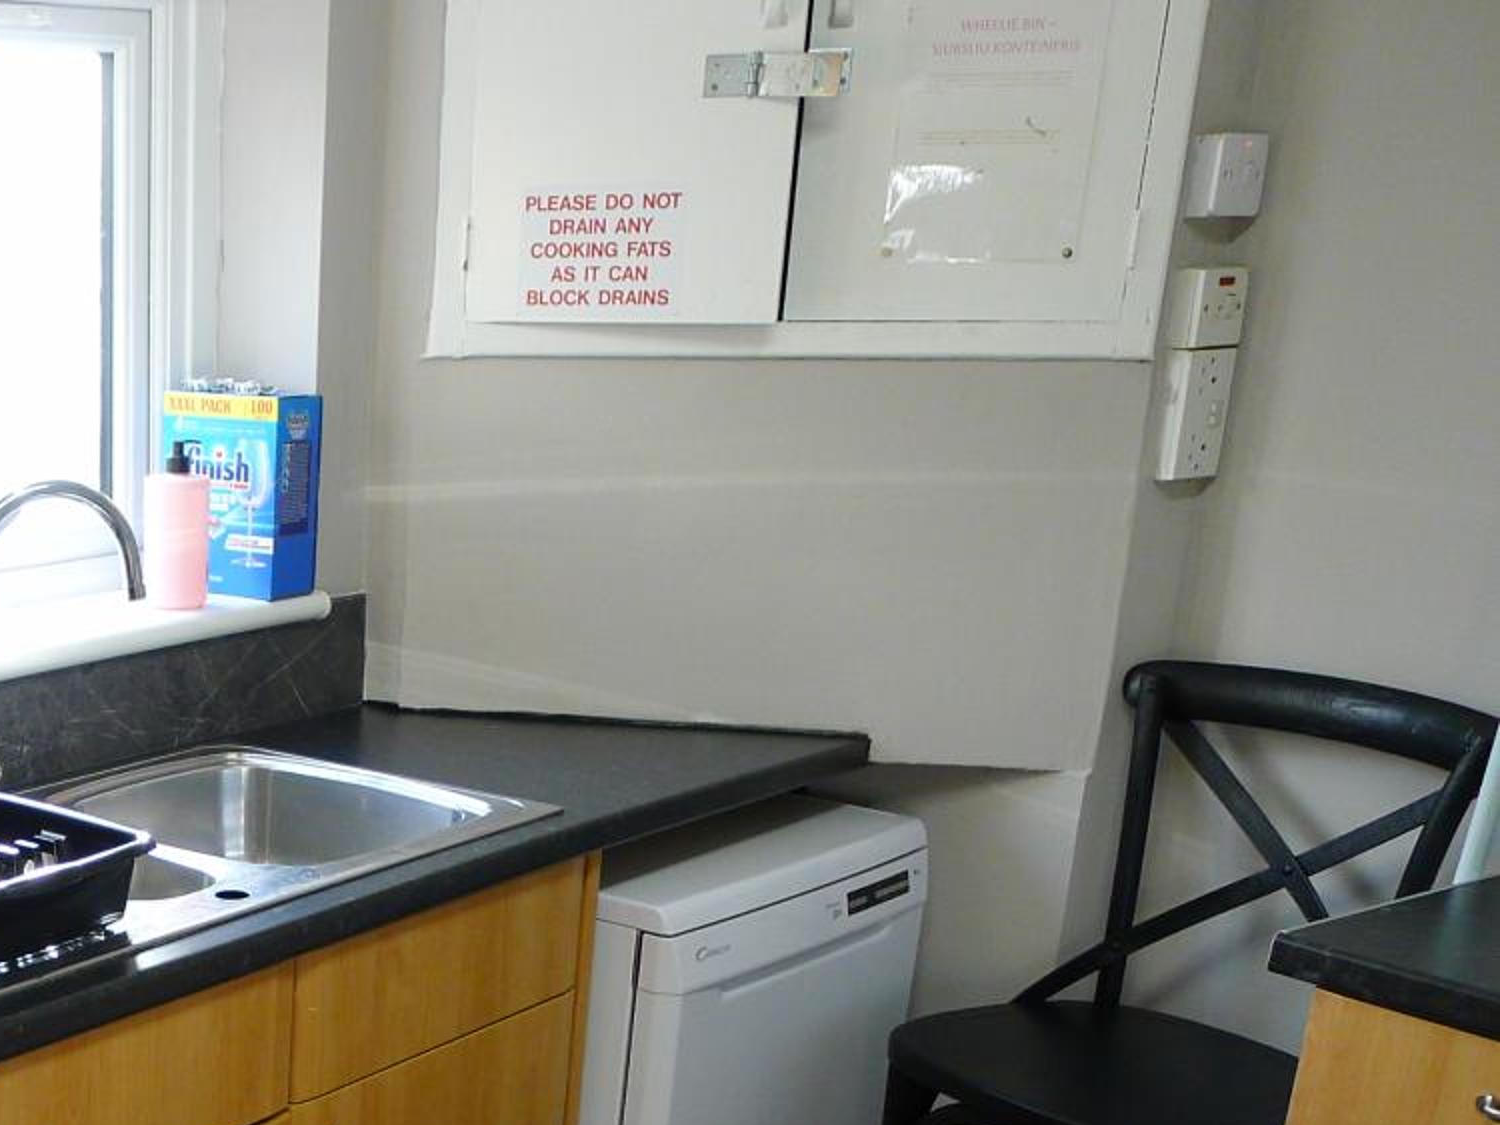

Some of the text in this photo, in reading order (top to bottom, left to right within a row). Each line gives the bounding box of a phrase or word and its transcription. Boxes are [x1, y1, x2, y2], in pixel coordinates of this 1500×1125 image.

[525, 192, 683, 211] PLEASE DO NOT
[549, 217, 653, 235] DRAIN ANY
[531, 240, 672, 259] COOKING FATS
[551, 265, 649, 282] AS IT CAN
[526, 289, 670, 306] BLOCK DRAINS
